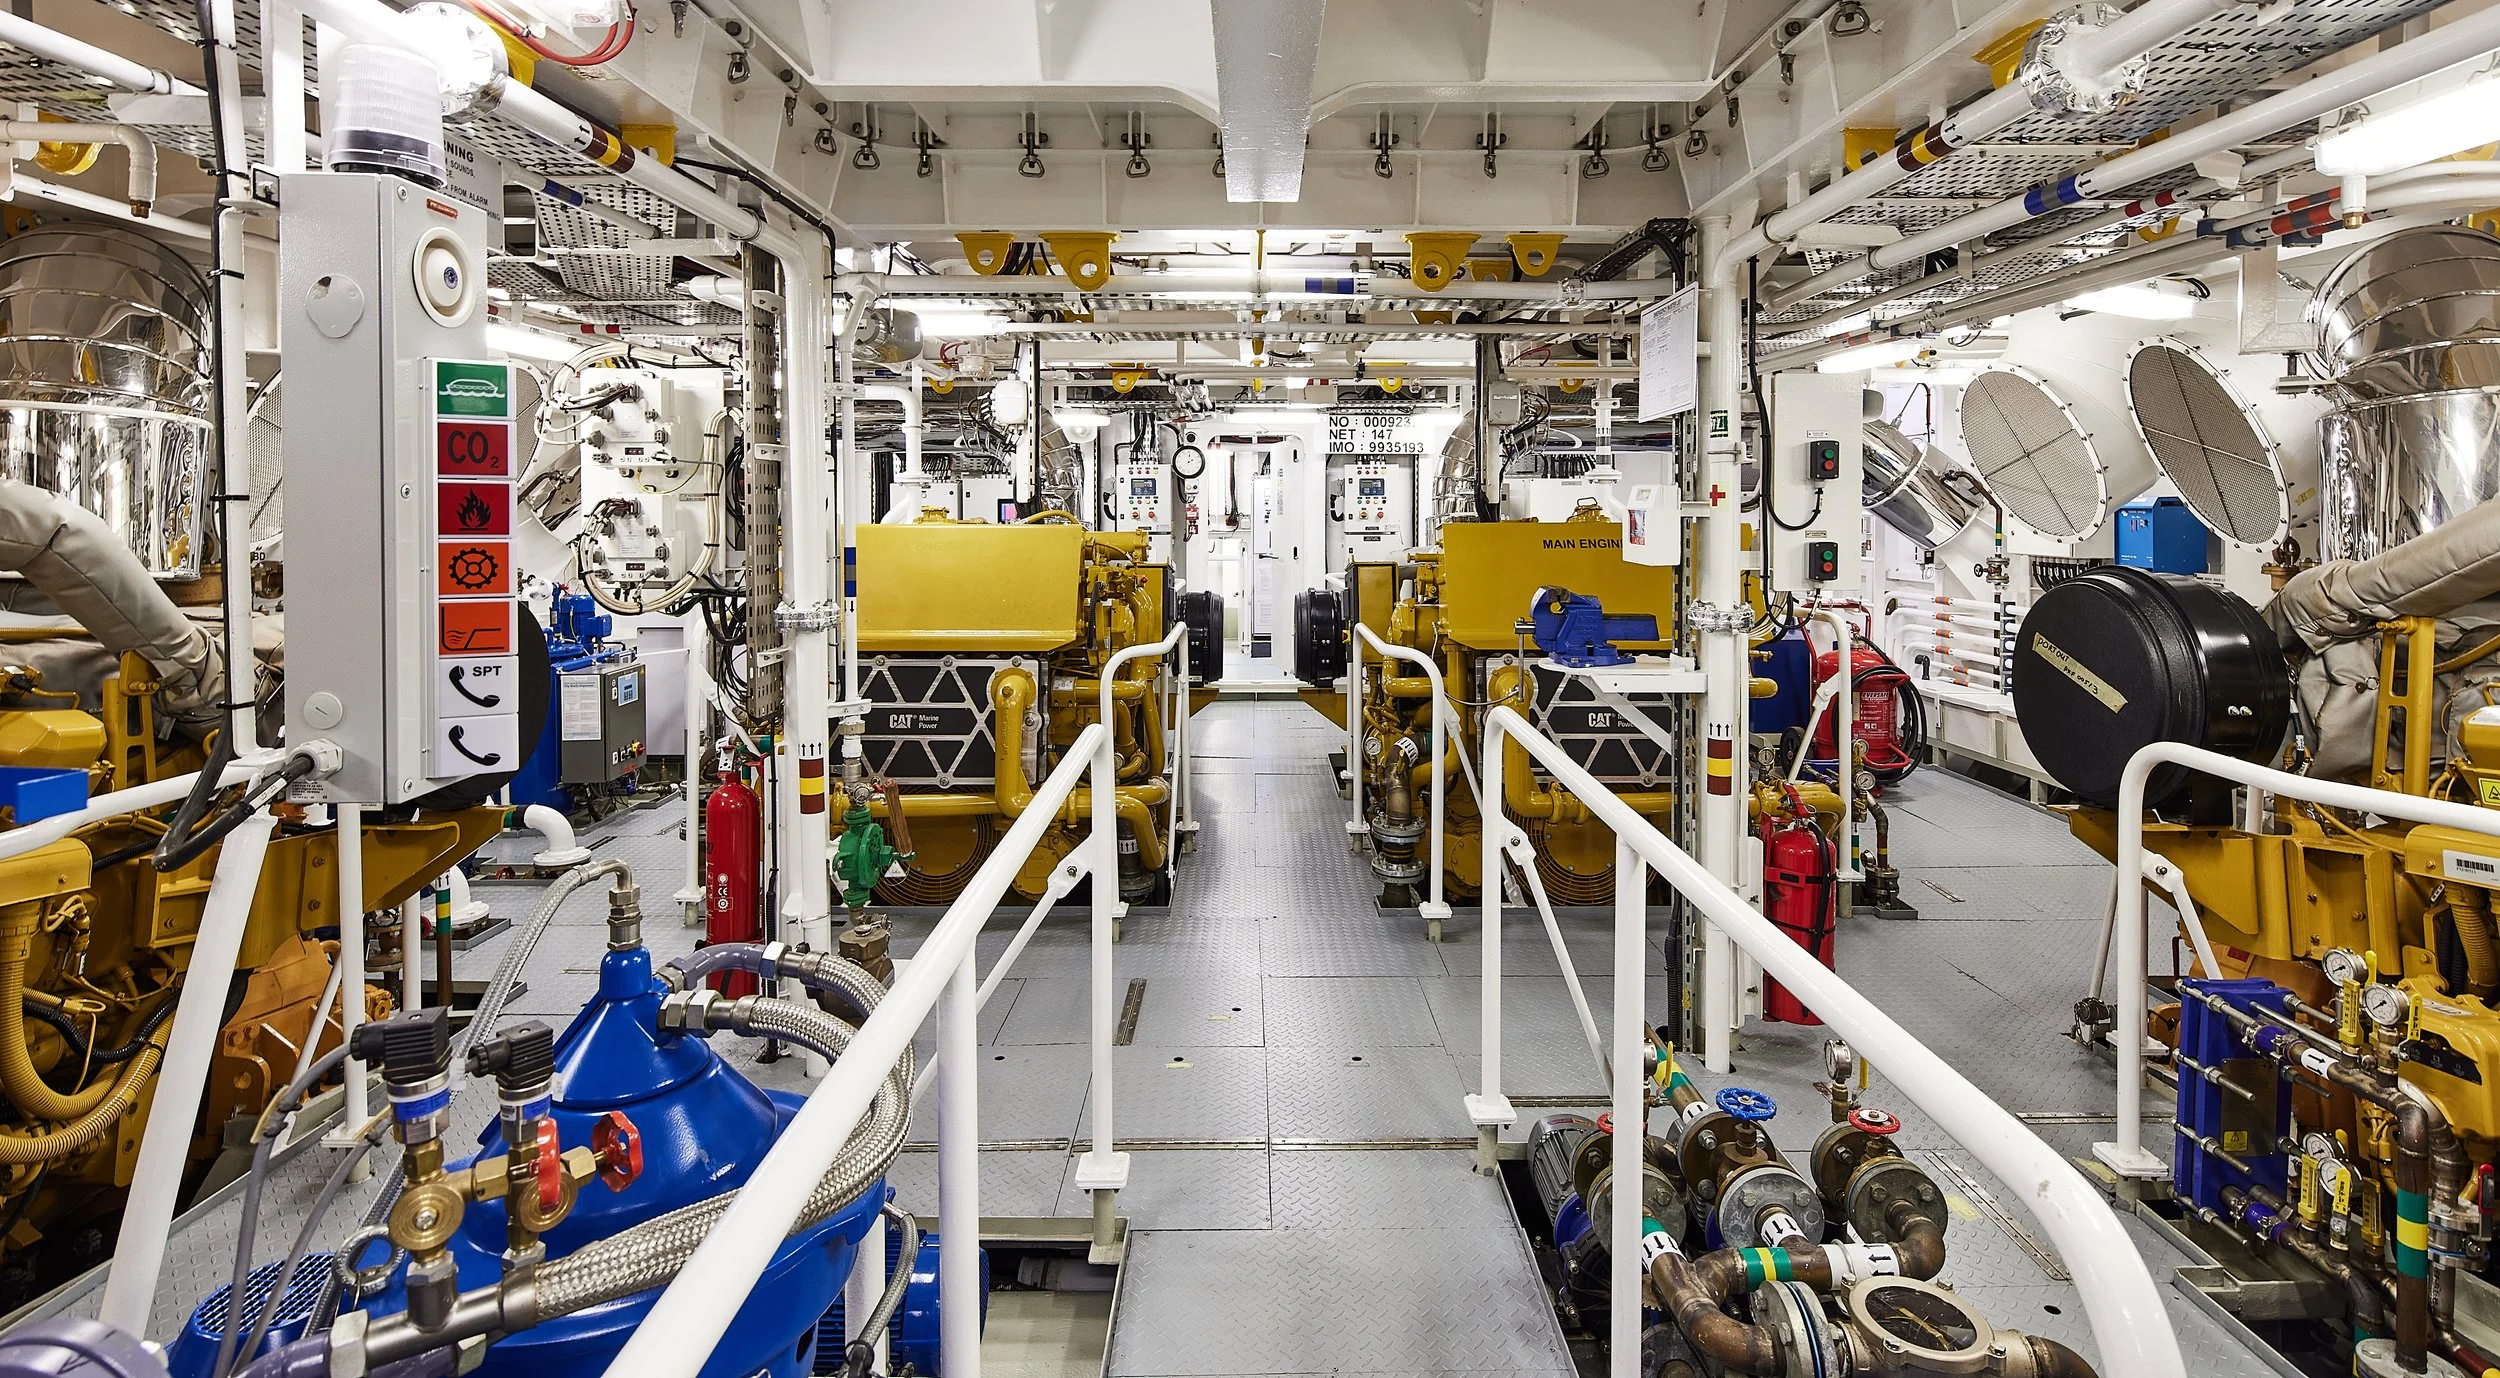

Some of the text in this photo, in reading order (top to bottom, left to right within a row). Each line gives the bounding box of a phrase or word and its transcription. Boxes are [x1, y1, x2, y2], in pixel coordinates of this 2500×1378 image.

[451, 184, 467, 197] FROM
[469, 192, 488, 206] ALARM
[1329, 416, 1349, 427] NO
[1329, 429, 1356, 440] NET
[1371, 429, 1393, 440] 147
[1329, 442, 1355, 453] IMO
[1369, 442, 1424, 453] 9935193
[1542, 539, 1575, 549] MAIN
[1579, 538, 1623, 549] ENGIN
[472, 665, 502, 677] SPT
[889, 714, 913, 729] CAT
[1588, 712, 1612, 728] CAT
